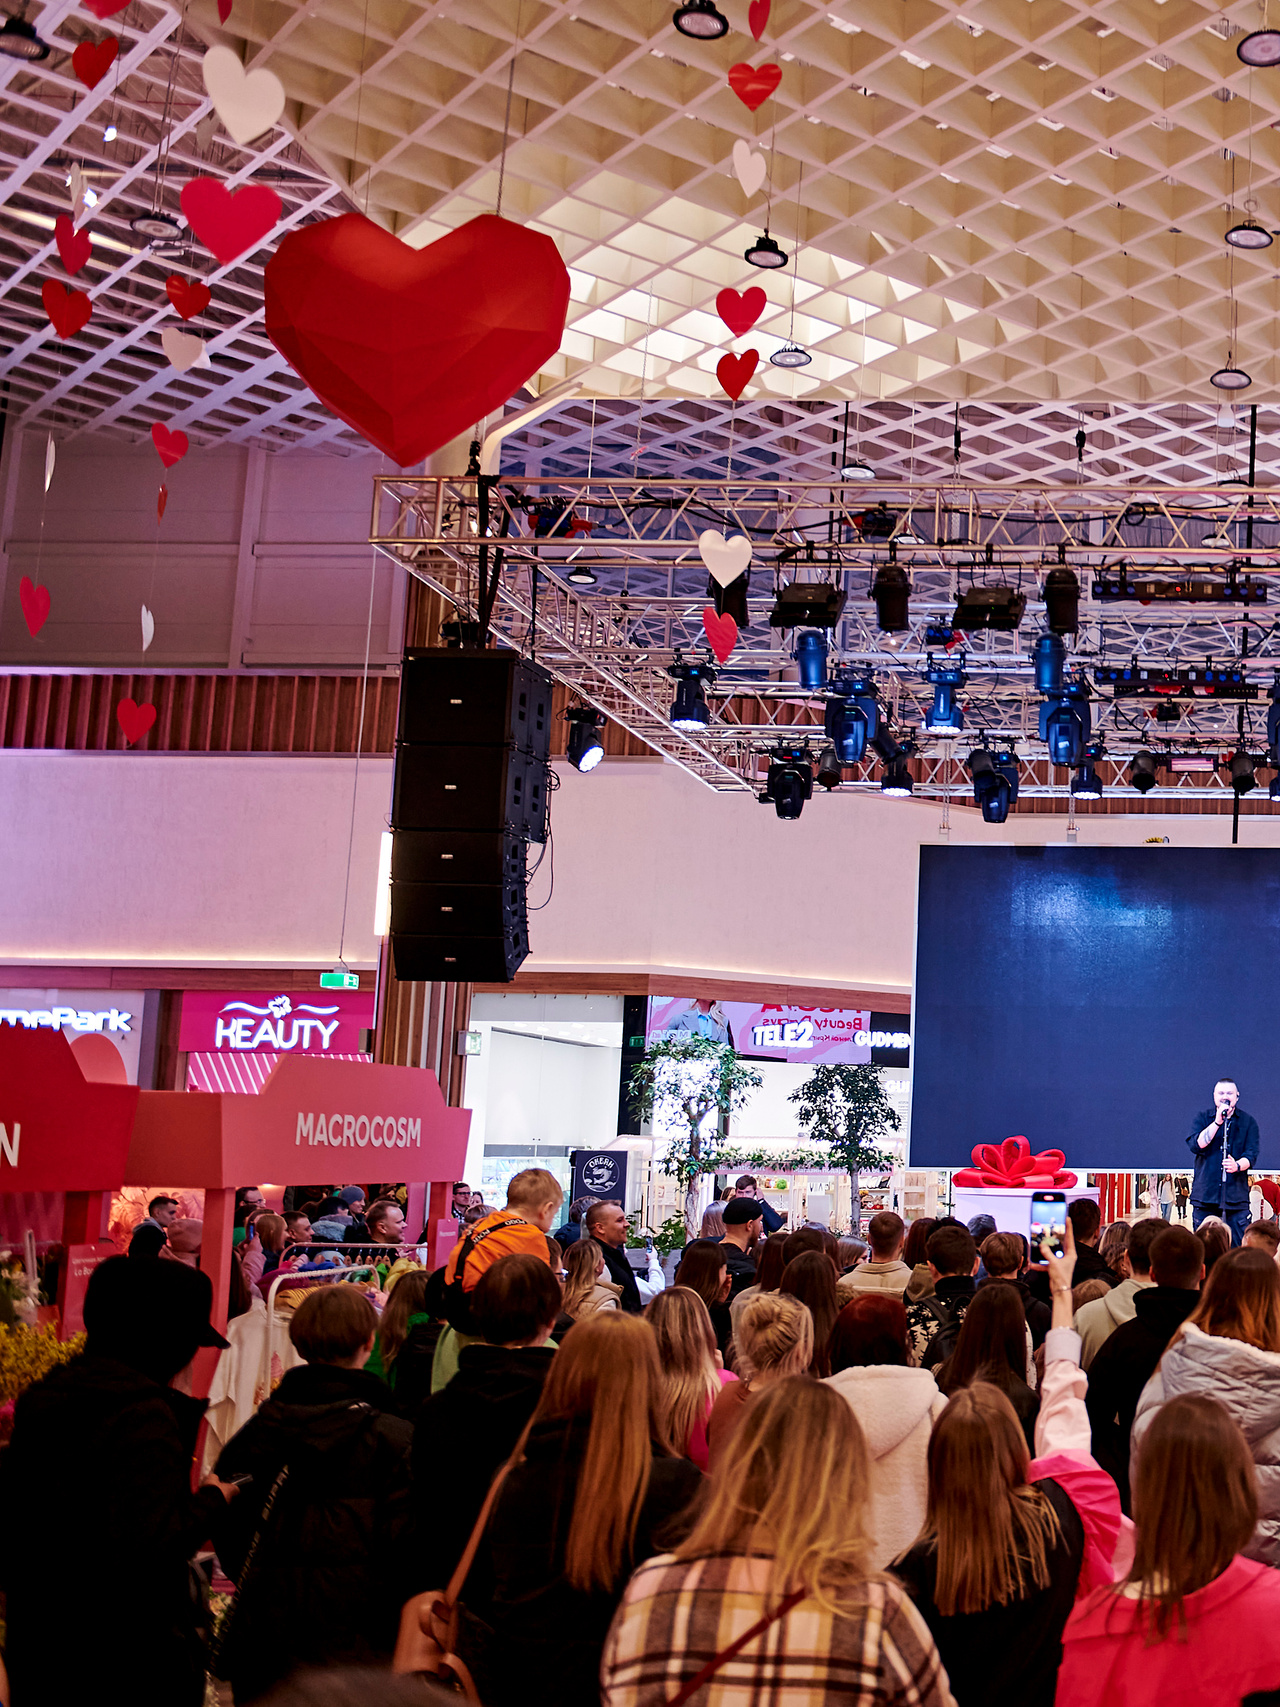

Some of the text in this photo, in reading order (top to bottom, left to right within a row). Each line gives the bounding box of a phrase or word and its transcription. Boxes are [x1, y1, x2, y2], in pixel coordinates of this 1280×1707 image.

[215, 1017, 340, 1050] KEAUTY
[753, 1021, 813, 1048] TELE2
[295, 1112, 421, 1148] MACROCOSM
